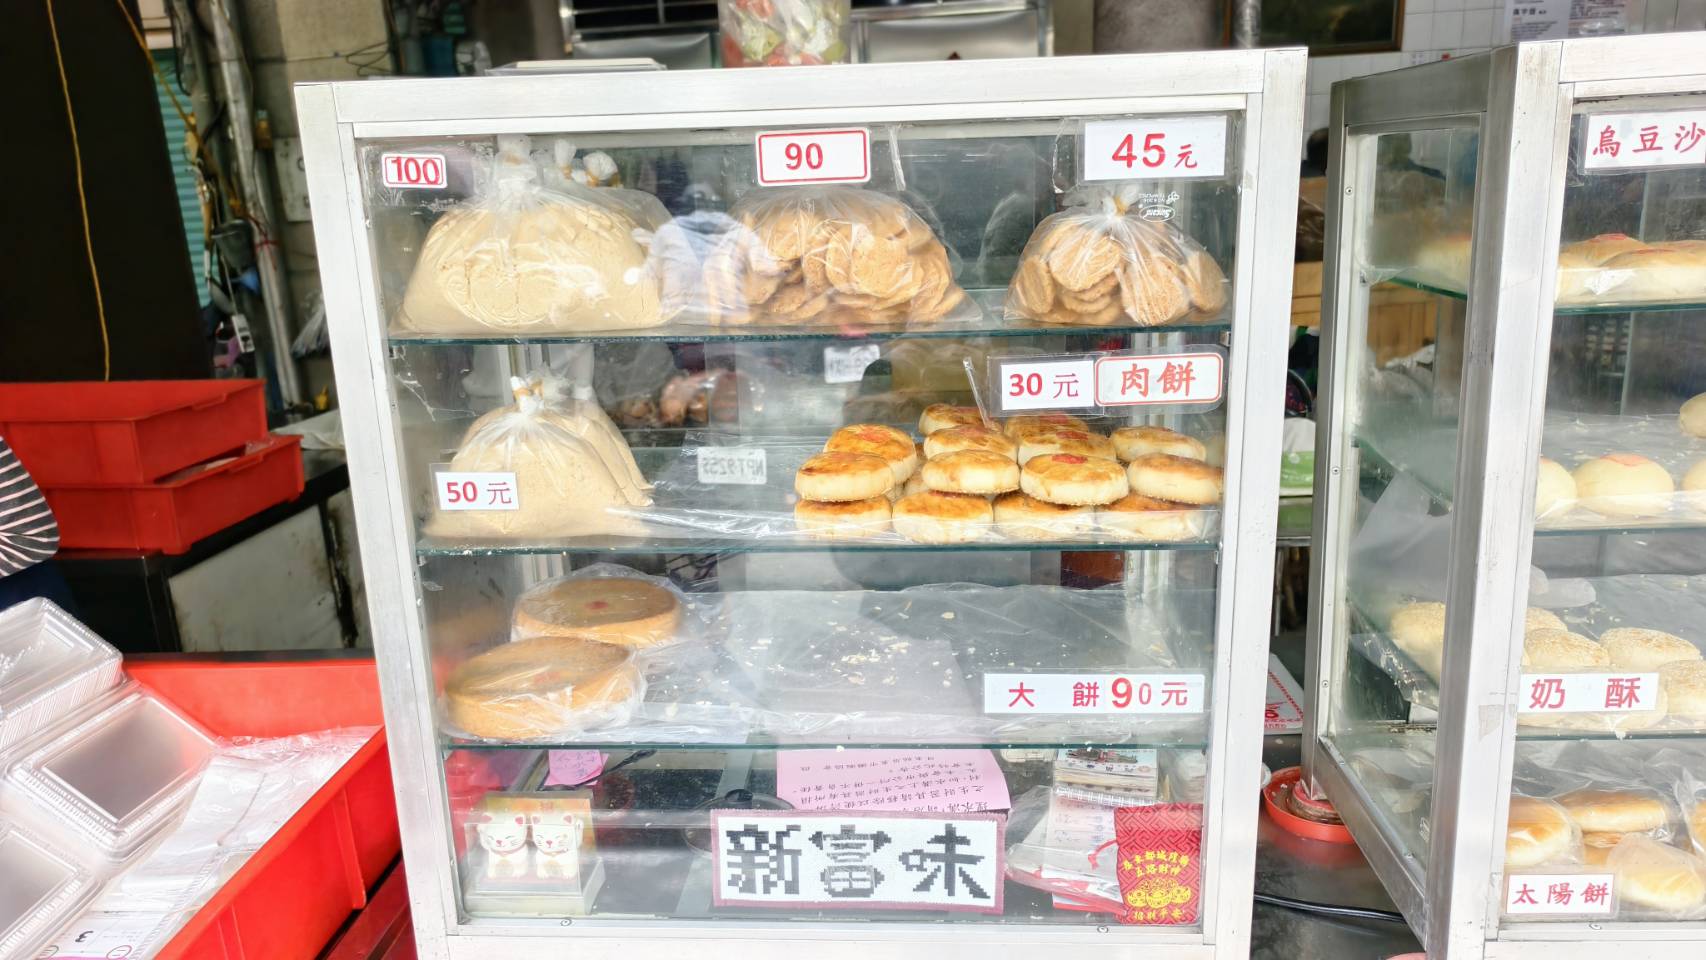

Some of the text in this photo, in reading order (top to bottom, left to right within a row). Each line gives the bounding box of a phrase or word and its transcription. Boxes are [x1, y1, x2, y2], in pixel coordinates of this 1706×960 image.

[1593, 122, 1706, 157] 烏豆沙
[391, 156, 440, 185] 100
[785, 143, 824, 170] 90
[1120, 361, 1196, 397] 肉餅
[1529, 678, 1641, 709] 奶酥
[726, 823, 991, 898] 新富味
[1512, 882, 1609, 906] 太陽餅
